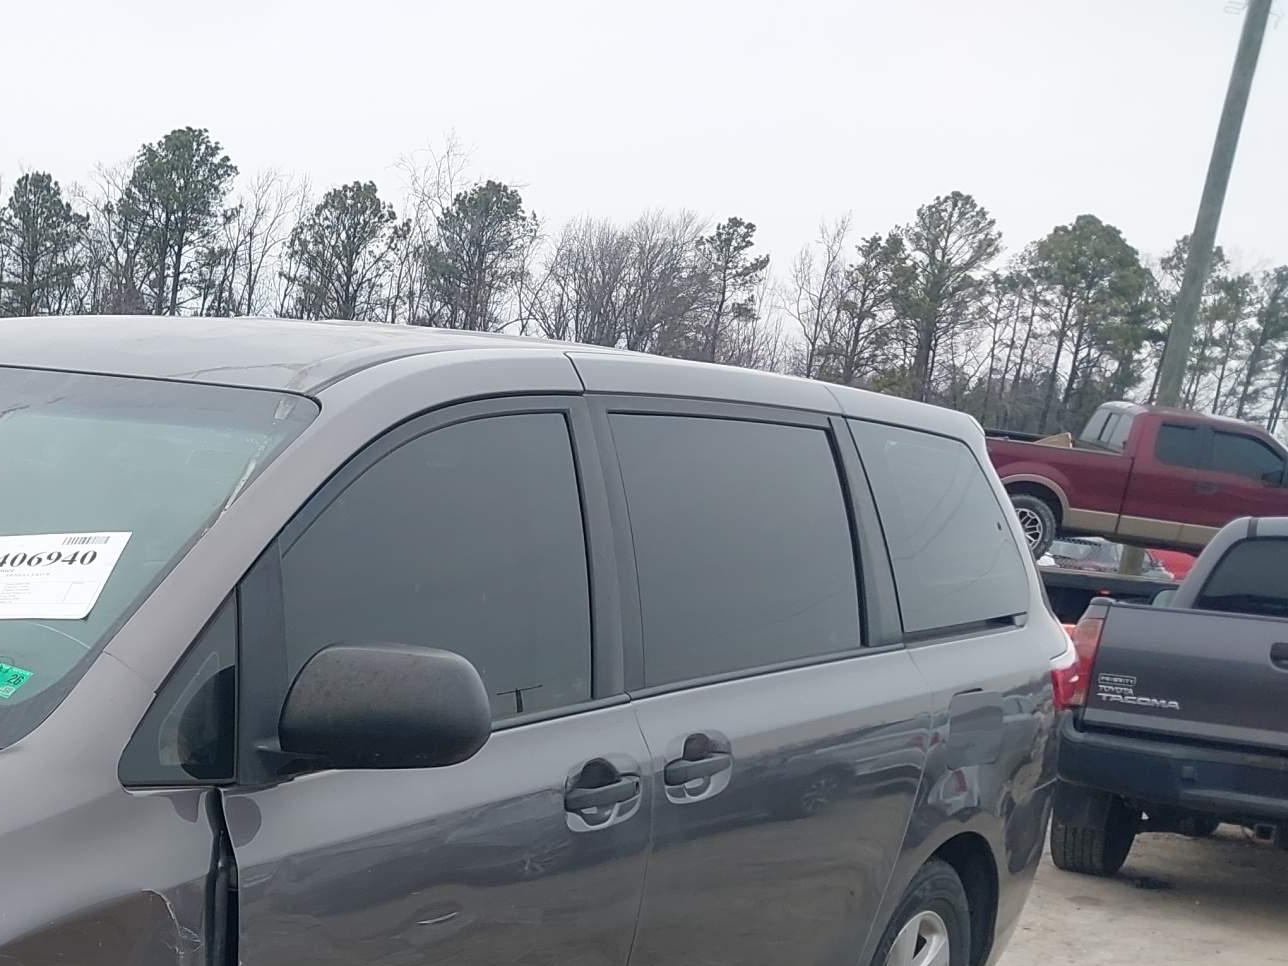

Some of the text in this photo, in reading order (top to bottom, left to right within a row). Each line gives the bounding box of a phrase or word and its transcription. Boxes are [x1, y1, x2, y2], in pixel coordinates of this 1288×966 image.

[7, 673, 25, 686] 26
[1098, 685, 1134, 695] TOYOTA
[1096, 692, 1180, 710] TACOMA
